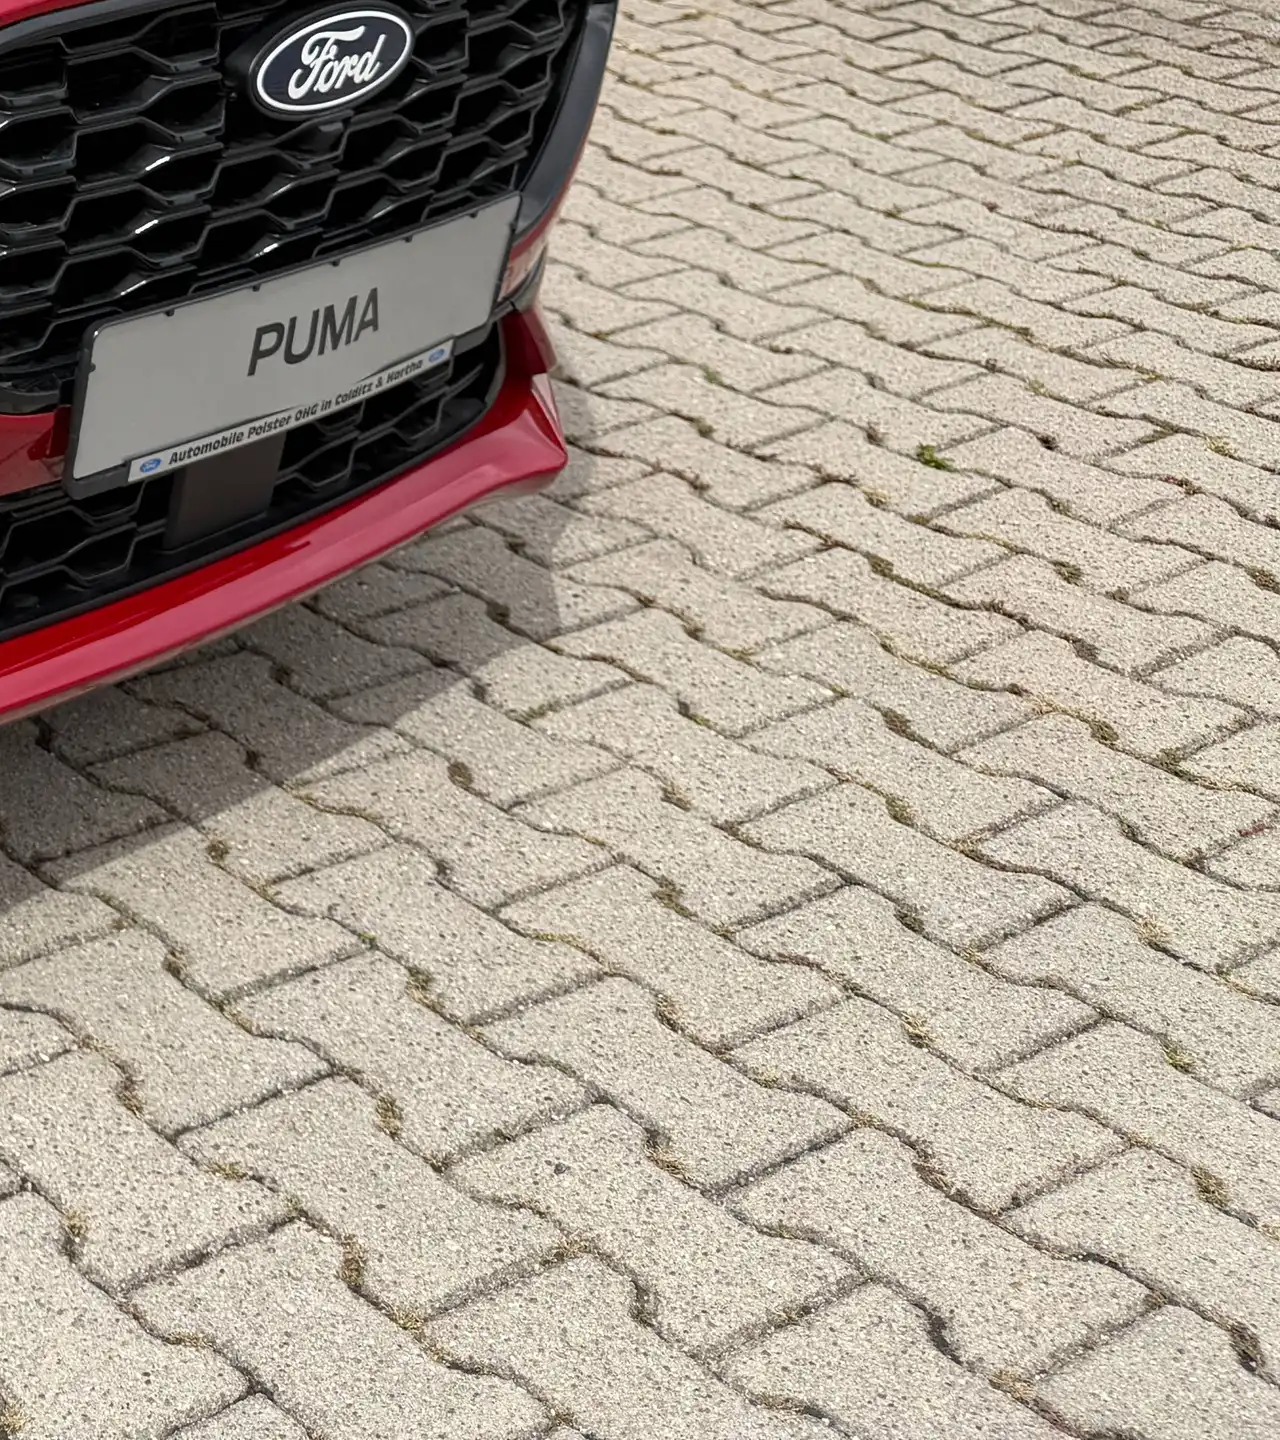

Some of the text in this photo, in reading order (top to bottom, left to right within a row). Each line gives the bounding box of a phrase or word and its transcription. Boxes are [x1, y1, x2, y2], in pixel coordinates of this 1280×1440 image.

[288, 25, 387, 99] Ford
[247, 287, 379, 377] PUMA
[169, 431, 244, 465] Automobile
[247, 414, 292, 439] Polster
[294, 403, 319, 421] OHG
[321, 399, 332, 411] in
[335, 381, 373, 405] Colditz
